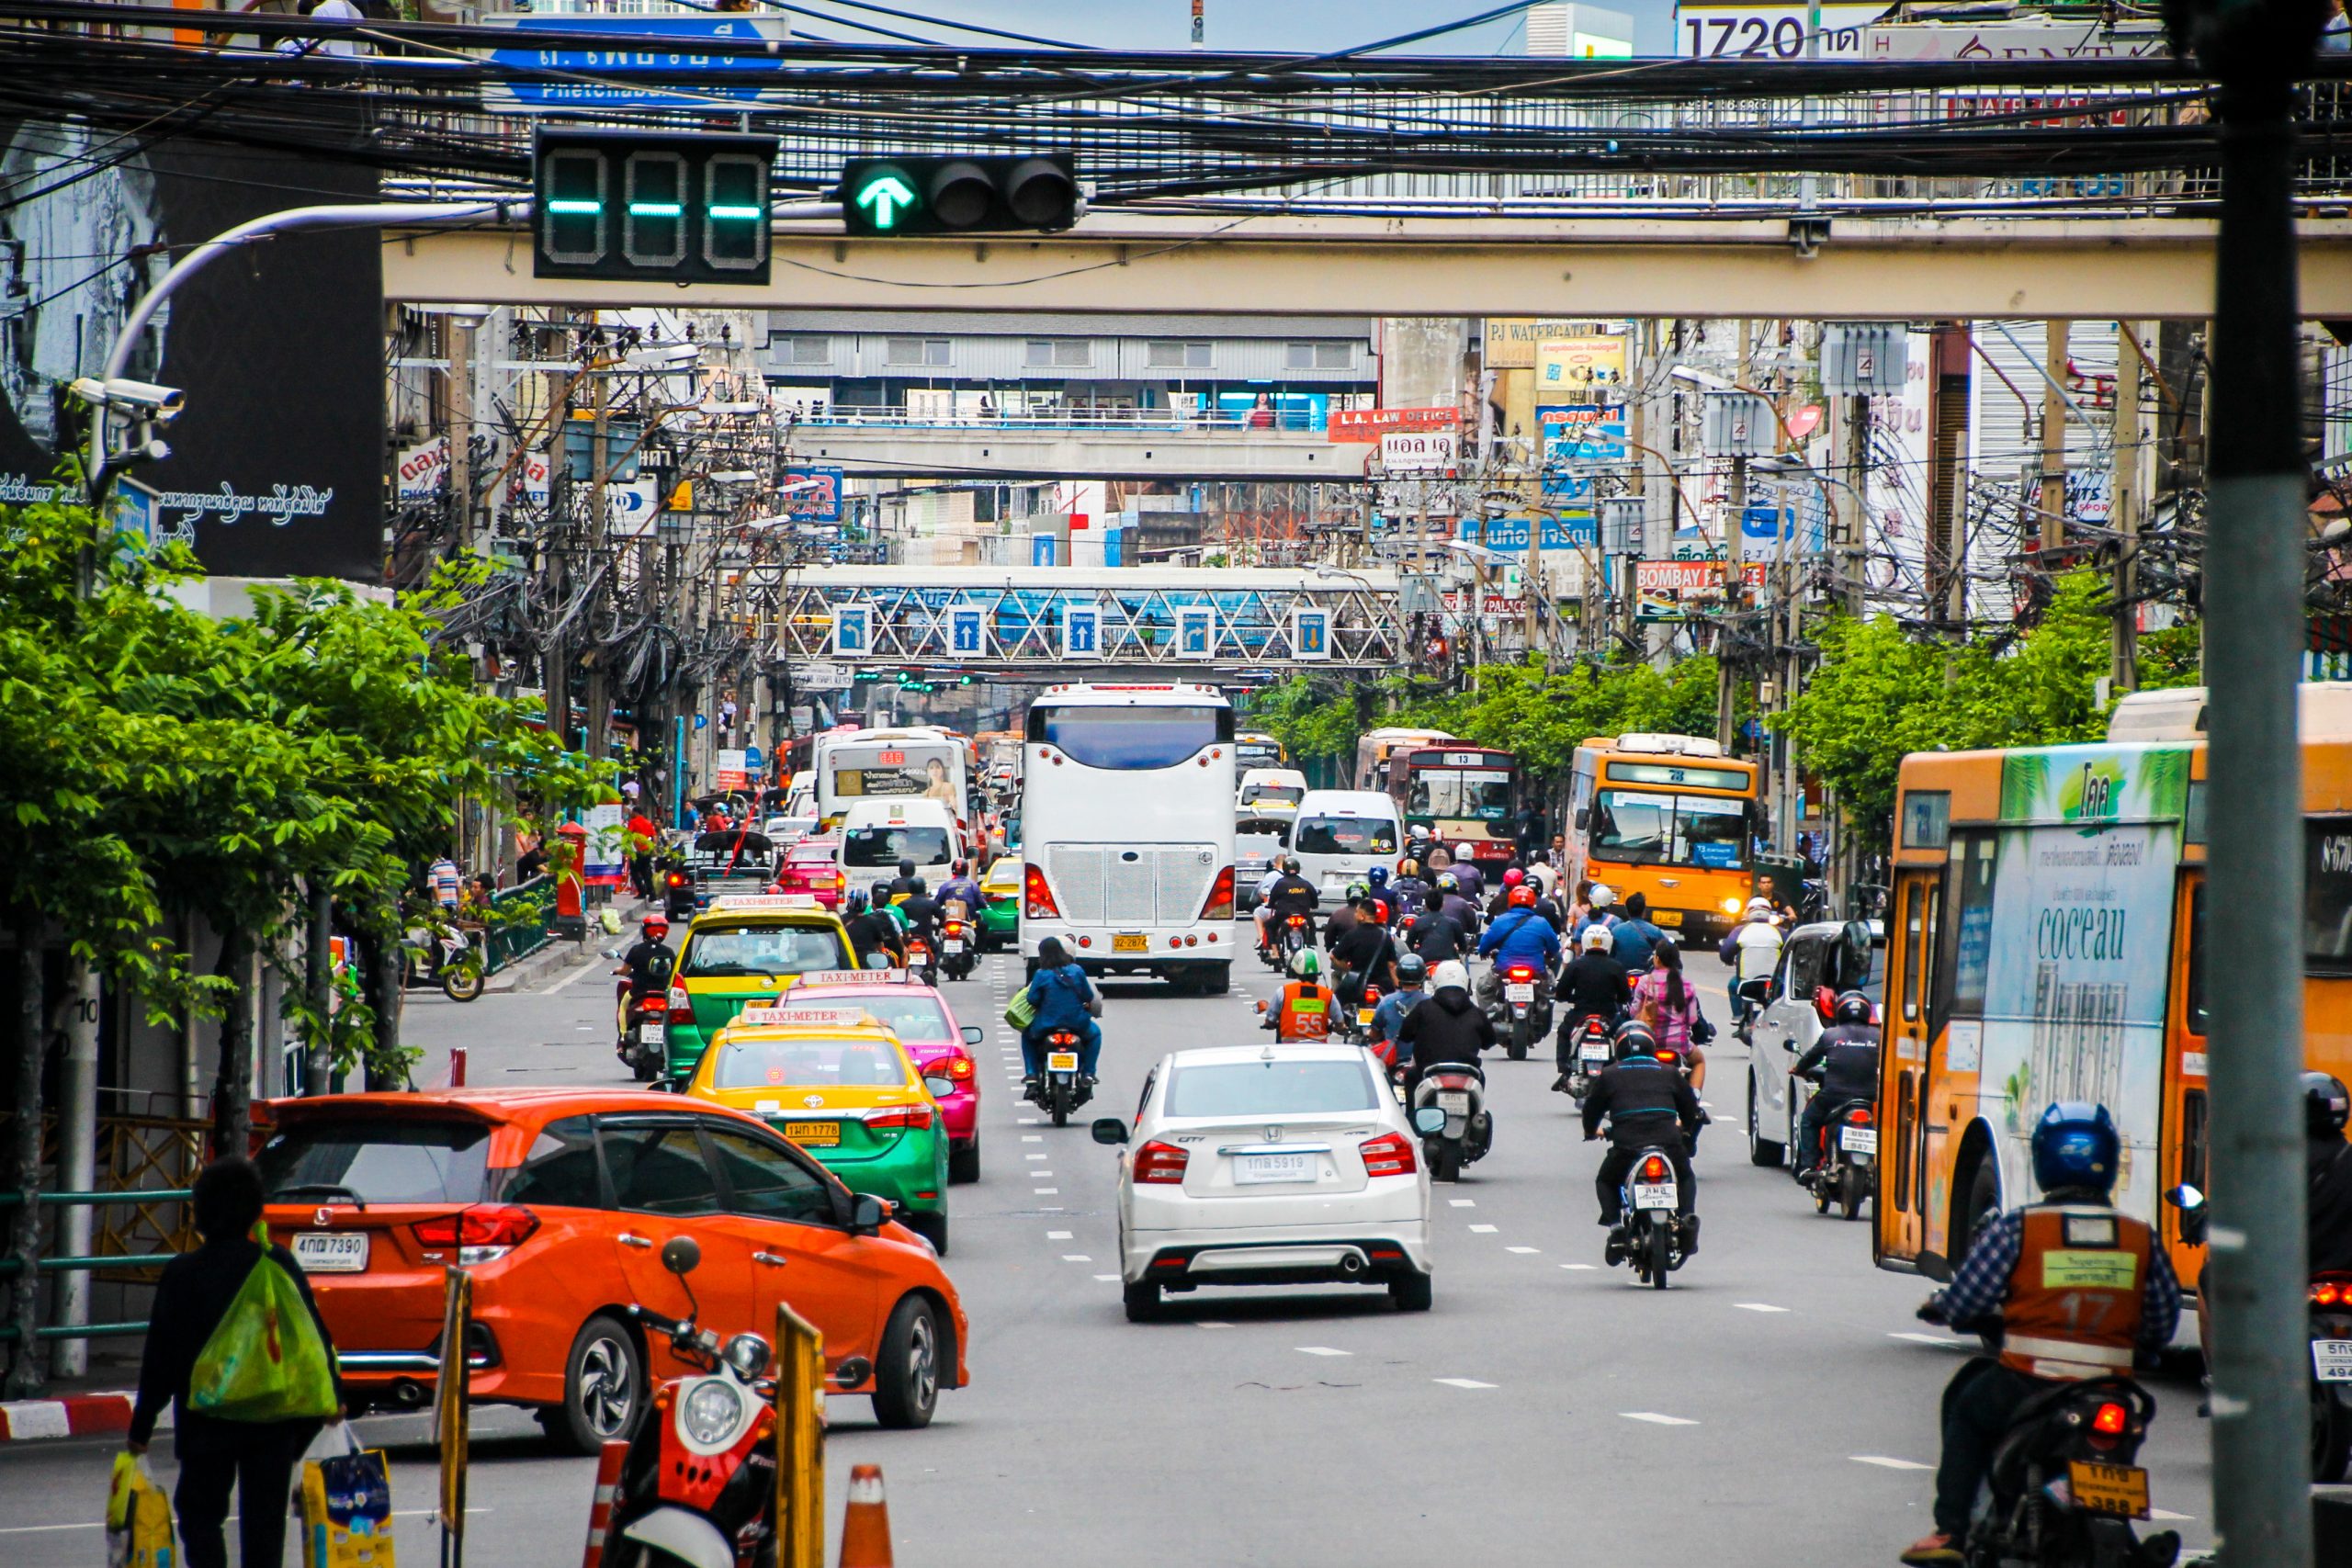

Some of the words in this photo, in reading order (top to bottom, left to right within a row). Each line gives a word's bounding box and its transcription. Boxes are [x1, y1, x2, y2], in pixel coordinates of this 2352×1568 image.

[1686, 17, 1804, 59] 1720
[1491, 324, 1507, 341] PJ
[1341, 413, 1368, 425] L.A.
[1373, 412, 1400, 423] LAW
[1407, 411, 1453, 422] OFFICE
[1387, 438, 1425, 454] แอล
[1637, 569, 1702, 588] BOMBAY
[1458, 756, 1469, 764] 13
[733, 897, 794, 906] TAXI-METER
[1114, 938, 1147, 948] 32-2874
[820, 972, 892, 982] TAXI-METER
[74, 998, 97, 1023] 10
[762, 1011, 838, 1021] TAXI-METER
[1295, 1013, 1322, 1034] 55
[811, 1122, 837, 1134] 1778
[1274, 1156, 1304, 1169] 5919
[329, 1238, 361, 1254] 7390
[2060, 1292, 2116, 1333] 17
